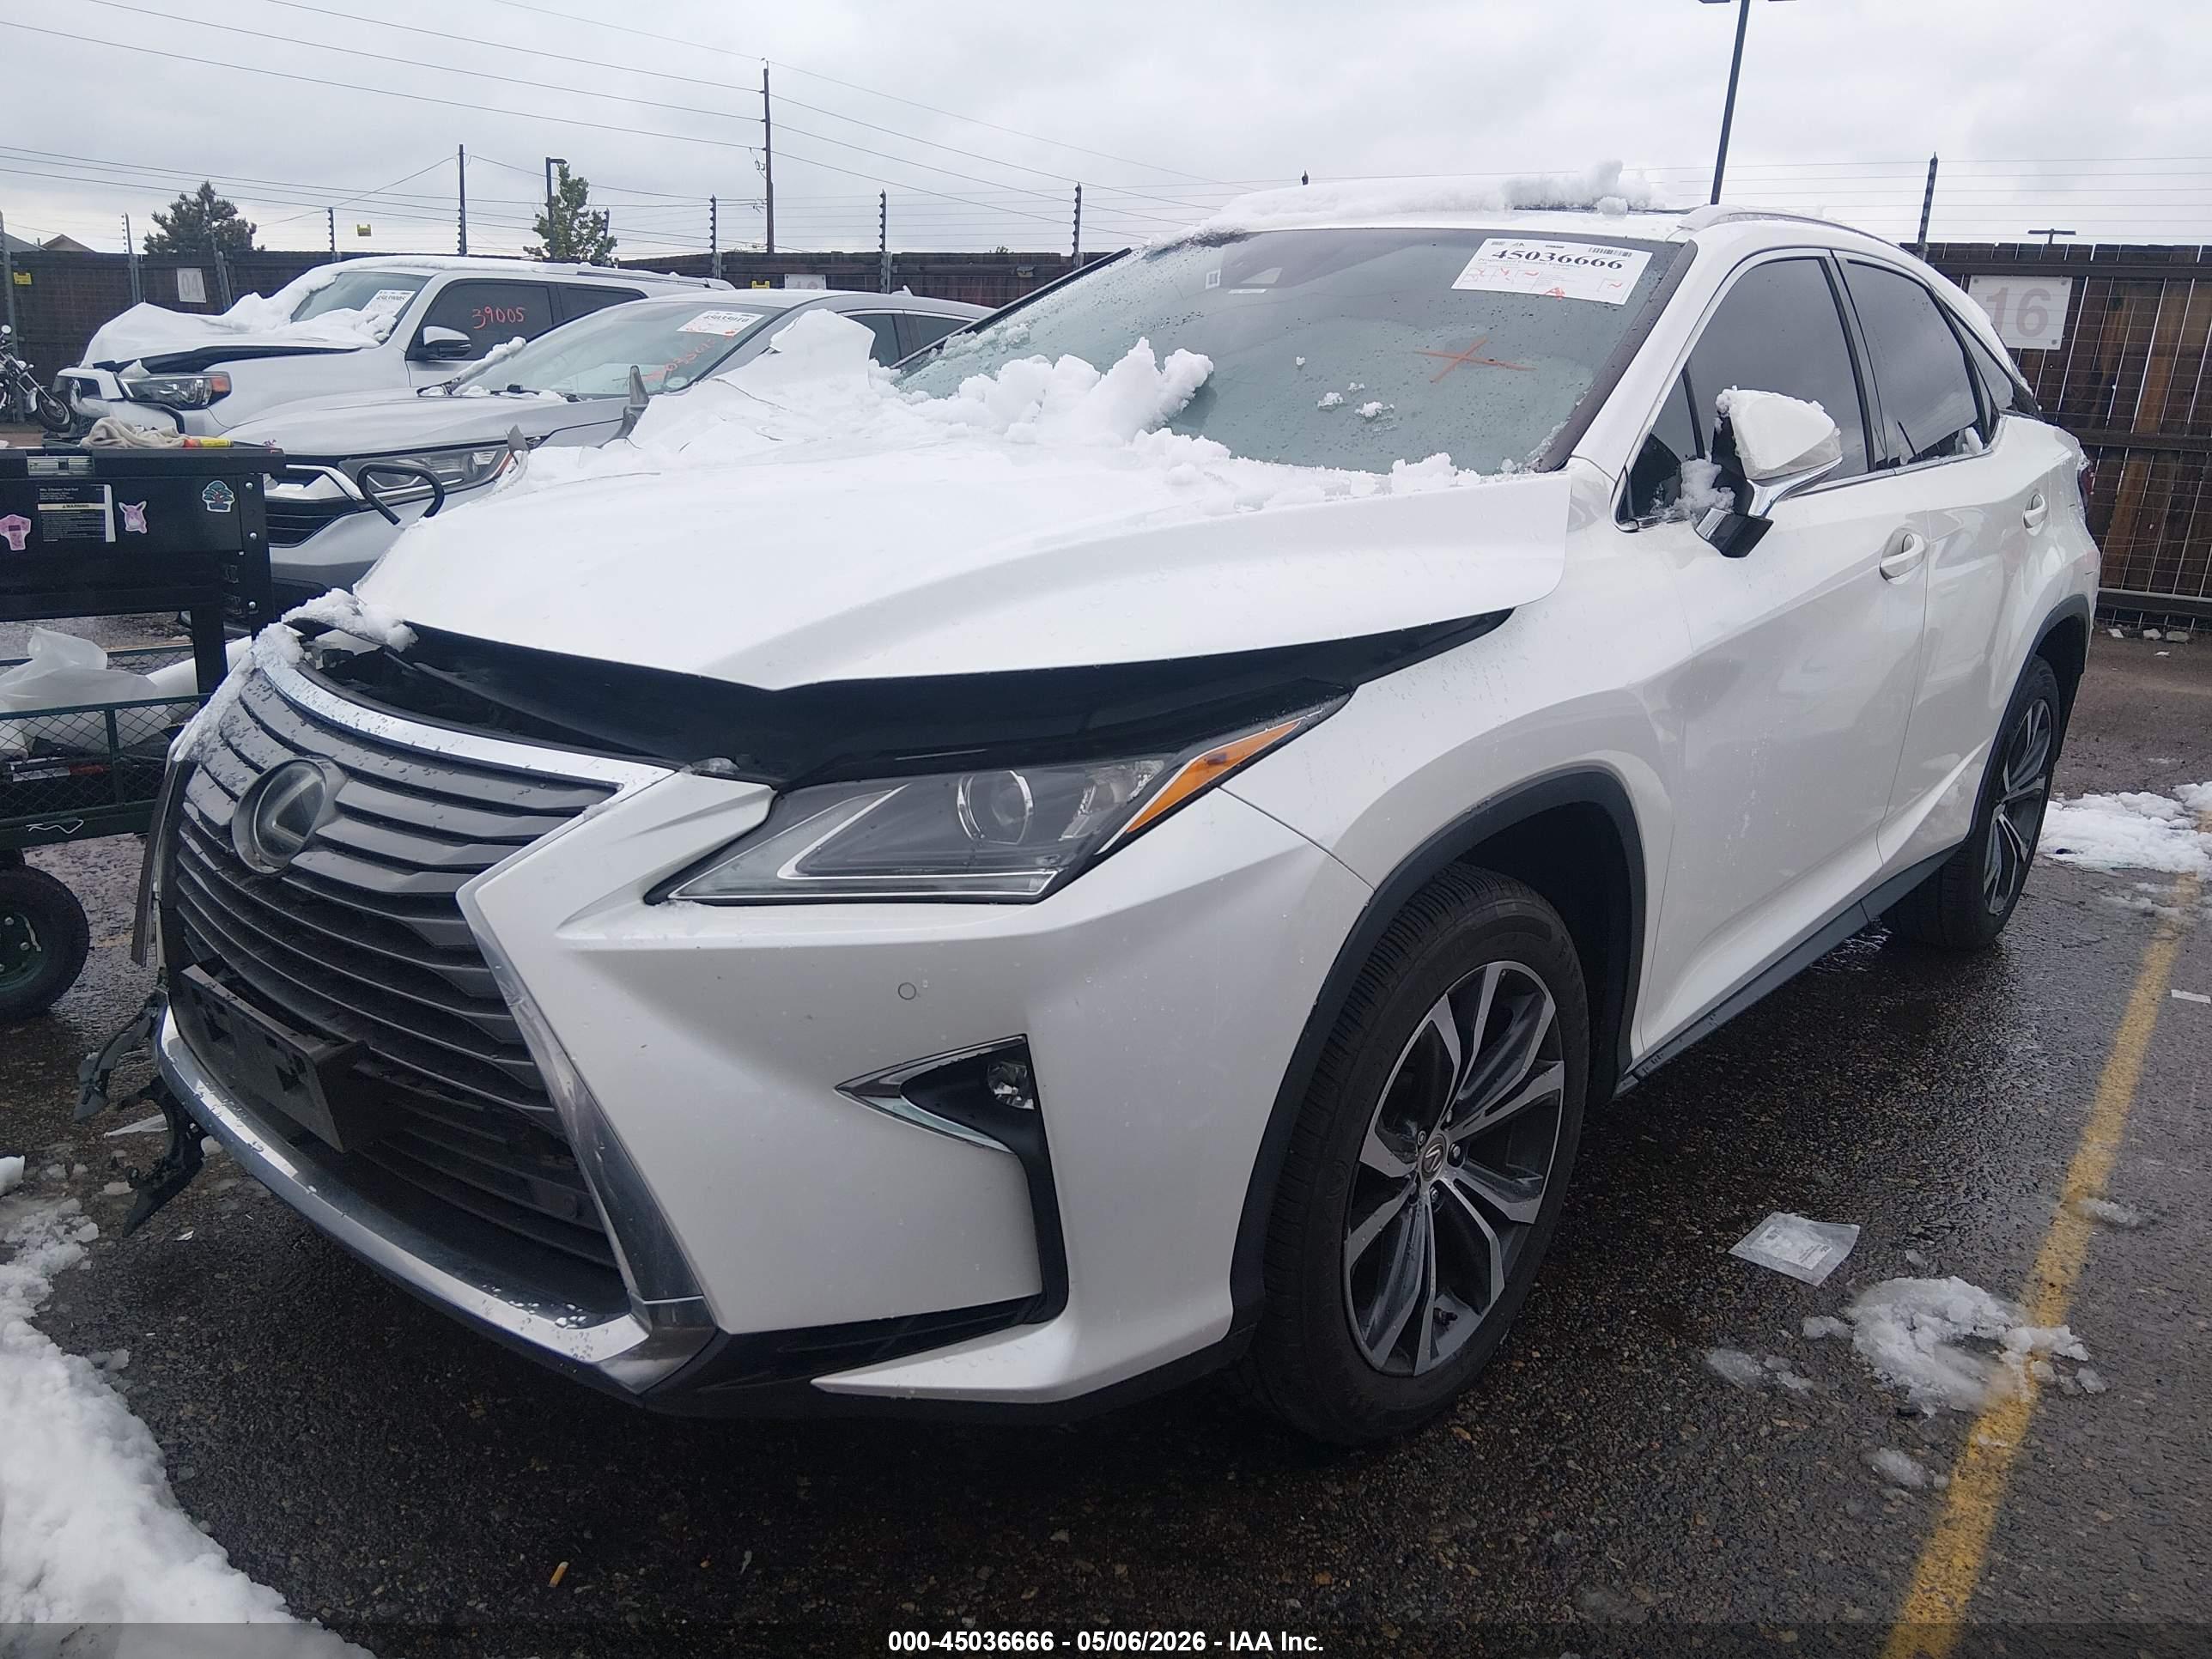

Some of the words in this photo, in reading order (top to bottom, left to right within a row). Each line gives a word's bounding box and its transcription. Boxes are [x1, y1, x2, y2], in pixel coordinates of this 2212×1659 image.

[1492, 249, 1626, 269] 45036666
[181, 273, 201, 297] 04
[472, 306, 526, 329] 39005
[1986, 287, 2051, 337] 16
